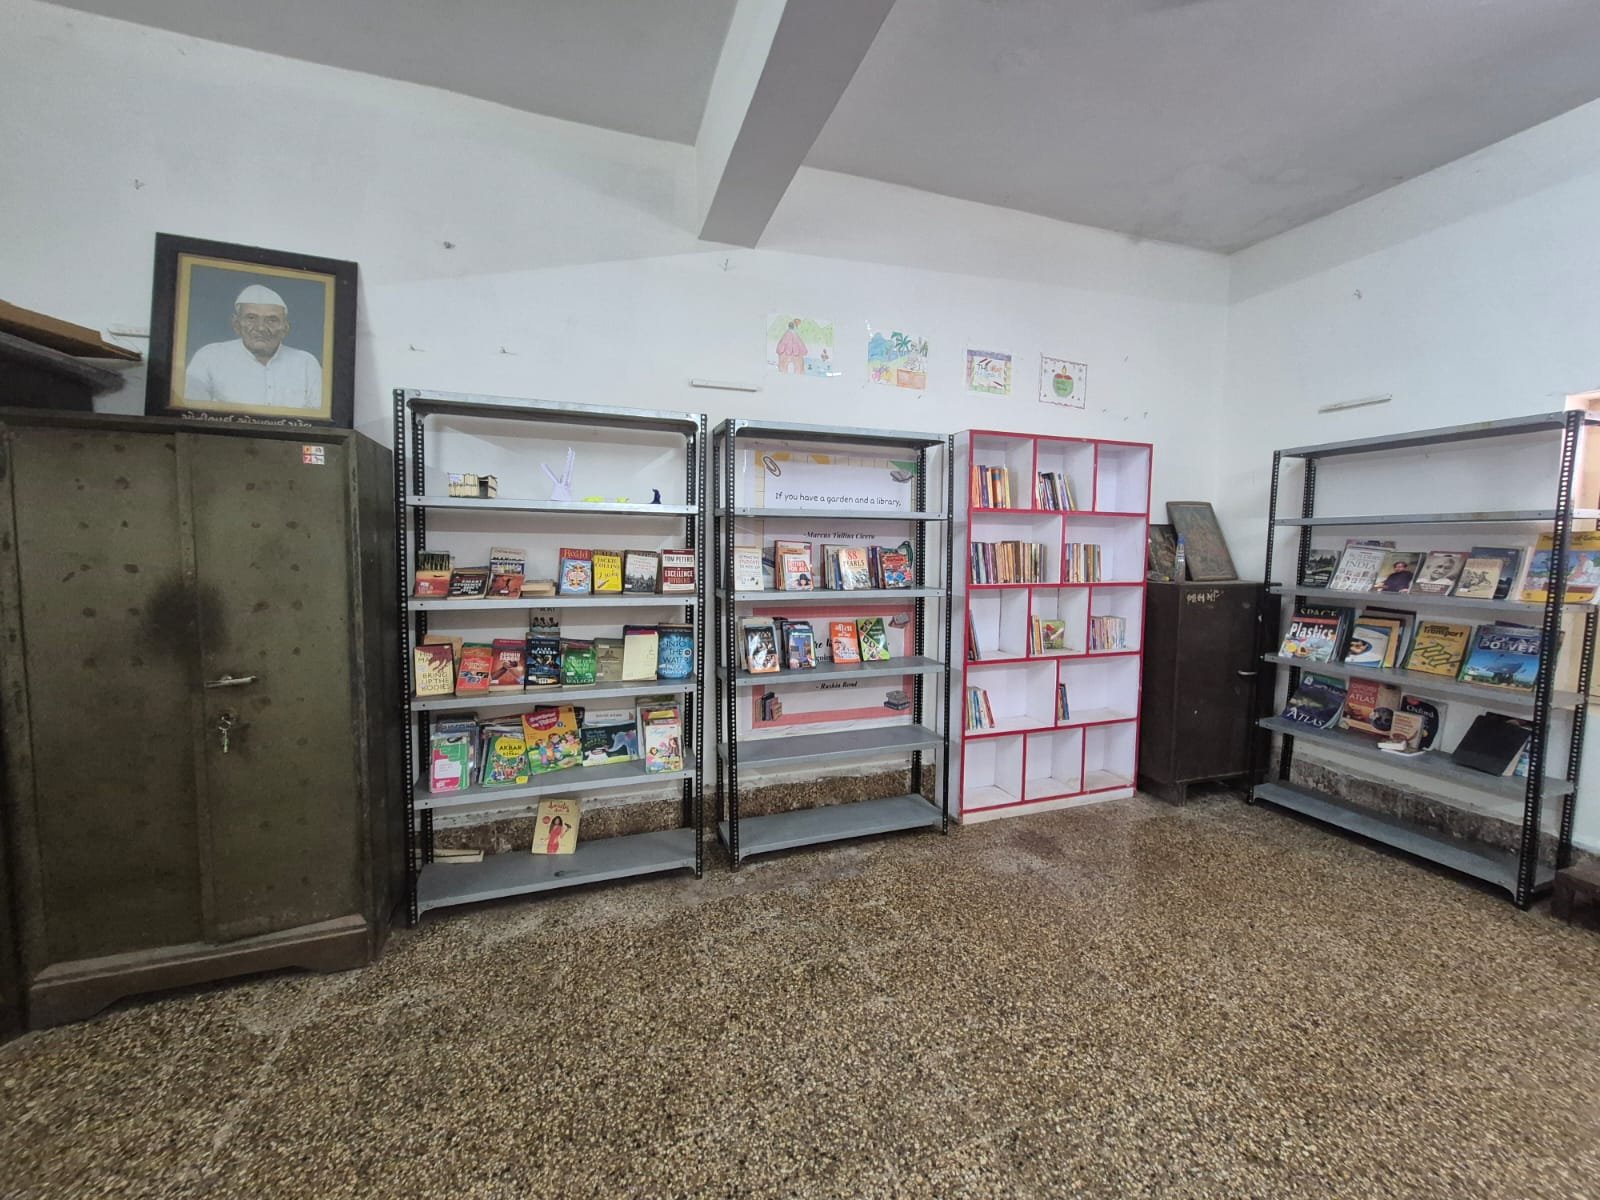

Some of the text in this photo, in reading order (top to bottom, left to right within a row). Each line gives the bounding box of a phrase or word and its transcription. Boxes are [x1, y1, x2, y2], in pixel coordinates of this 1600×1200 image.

[775, 491, 783, 500] If
[784, 494, 798, 503] you
[799, 493, 819, 502] have
[826, 495, 854, 504] garden
[854, 496, 869, 504] and
[876, 497, 902, 508] library,
[664, 555, 694, 563] TOM PETERS
[1346, 560, 1376, 570] INDIA
[664, 569, 694, 578] EXCELLENCE
[1300, 607, 1337, 617] SPACE
[1289, 622, 1334, 641] Plastics
[1423, 625, 1464, 638] Transport
[666, 640, 688, 648] INTO
[1480, 638, 1538, 654] POWER
[669, 648, 682, 656] THE
[1349, 693, 1376, 705] ATLAS
[1286, 706, 1324, 728] ATLAS
[1406, 704, 1435, 718] Oxford
